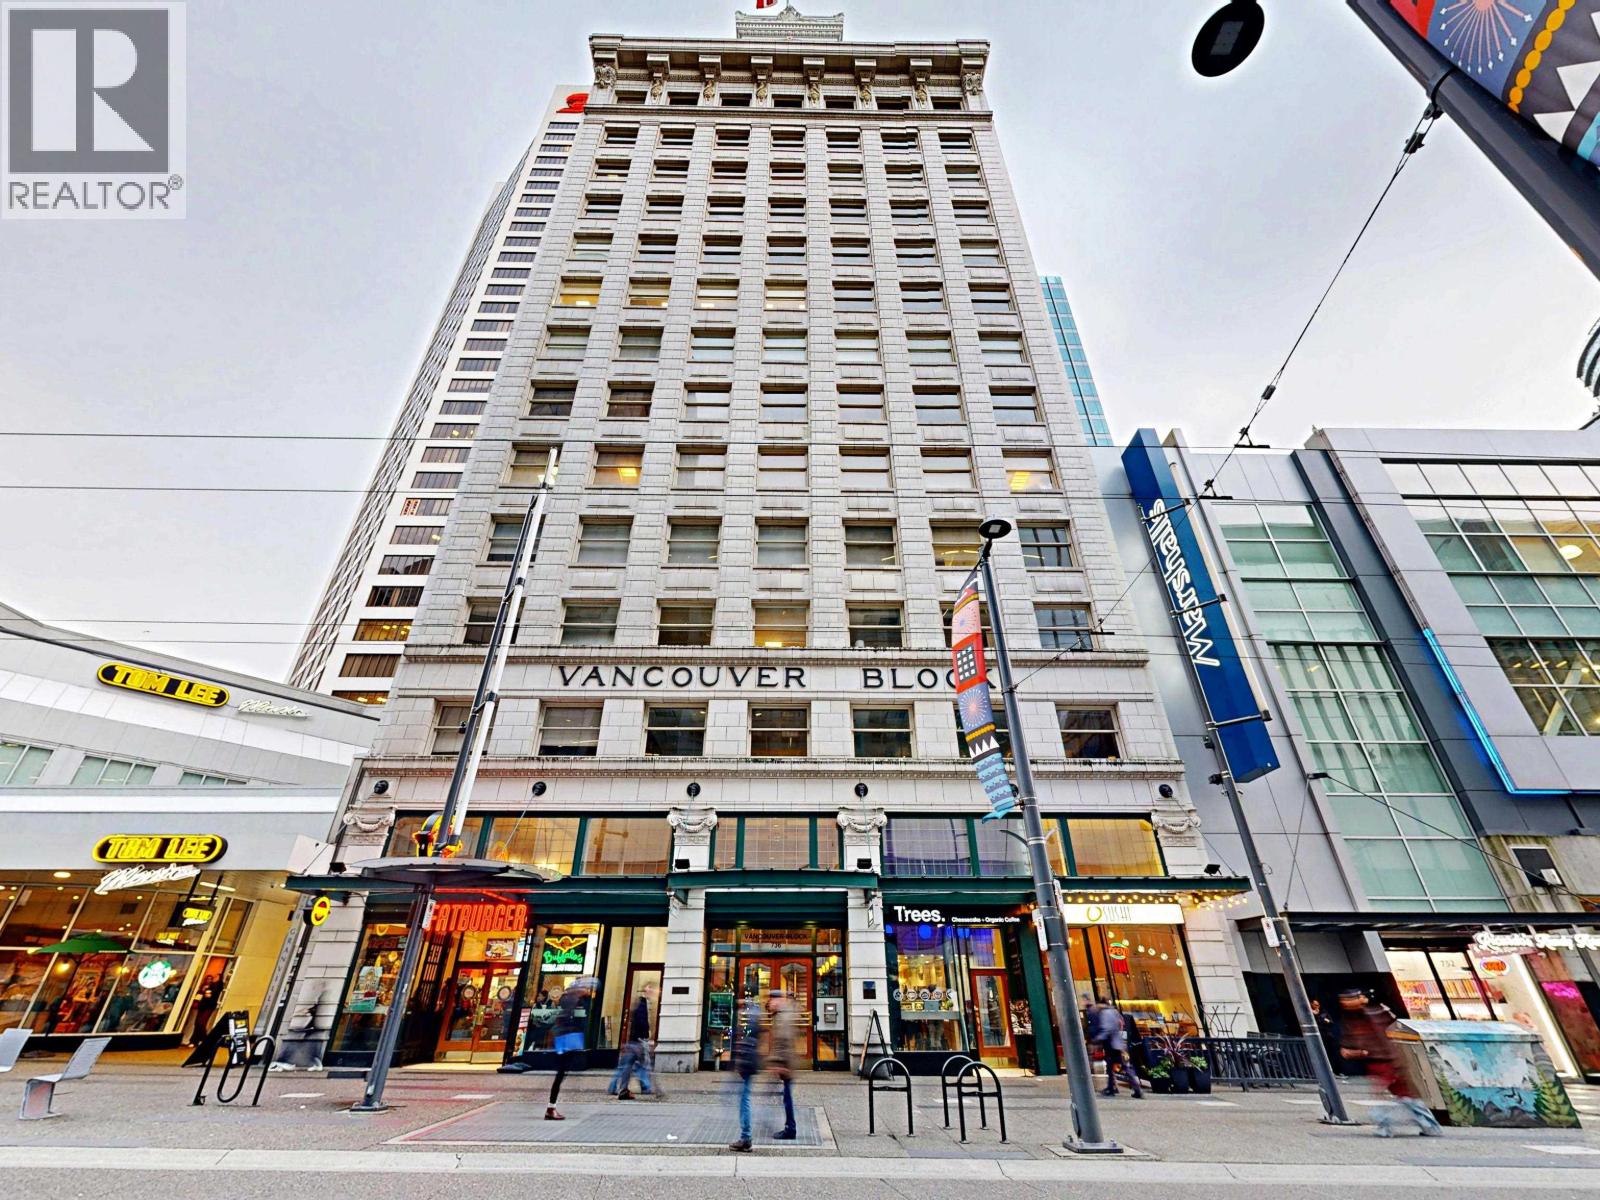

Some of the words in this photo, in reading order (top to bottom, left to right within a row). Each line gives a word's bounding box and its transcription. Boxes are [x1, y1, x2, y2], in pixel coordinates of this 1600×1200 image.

[1149, 498, 1221, 667] Marshalls
[112, 665, 169, 693] TOM
[174, 681, 220, 704] LEE
[558, 665, 806, 688] VANCOUVER
[105, 838, 162, 859] TOM
[164, 838, 213, 859] LEE
[429, 903, 527, 932] FATBURGER
[985, 916, 1004, 924] Organic
